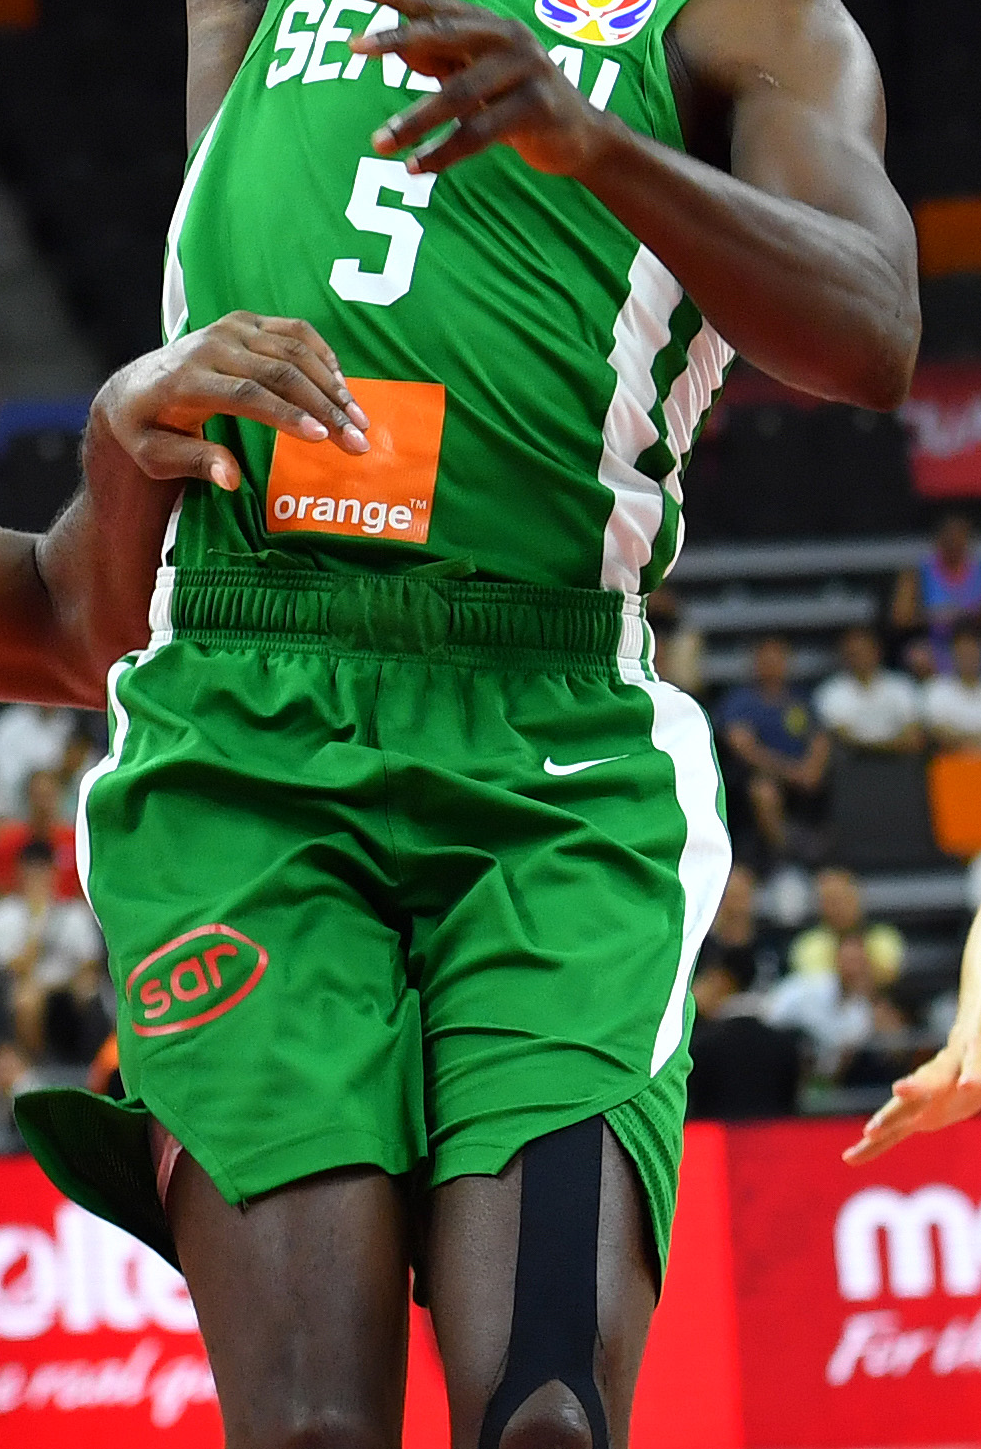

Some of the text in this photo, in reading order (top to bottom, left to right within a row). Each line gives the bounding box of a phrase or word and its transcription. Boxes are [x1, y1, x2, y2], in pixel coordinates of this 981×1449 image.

[328, 156, 437, 307] 5
[273, 494, 412, 534] orange
[139, 943, 238, 1019] sar
